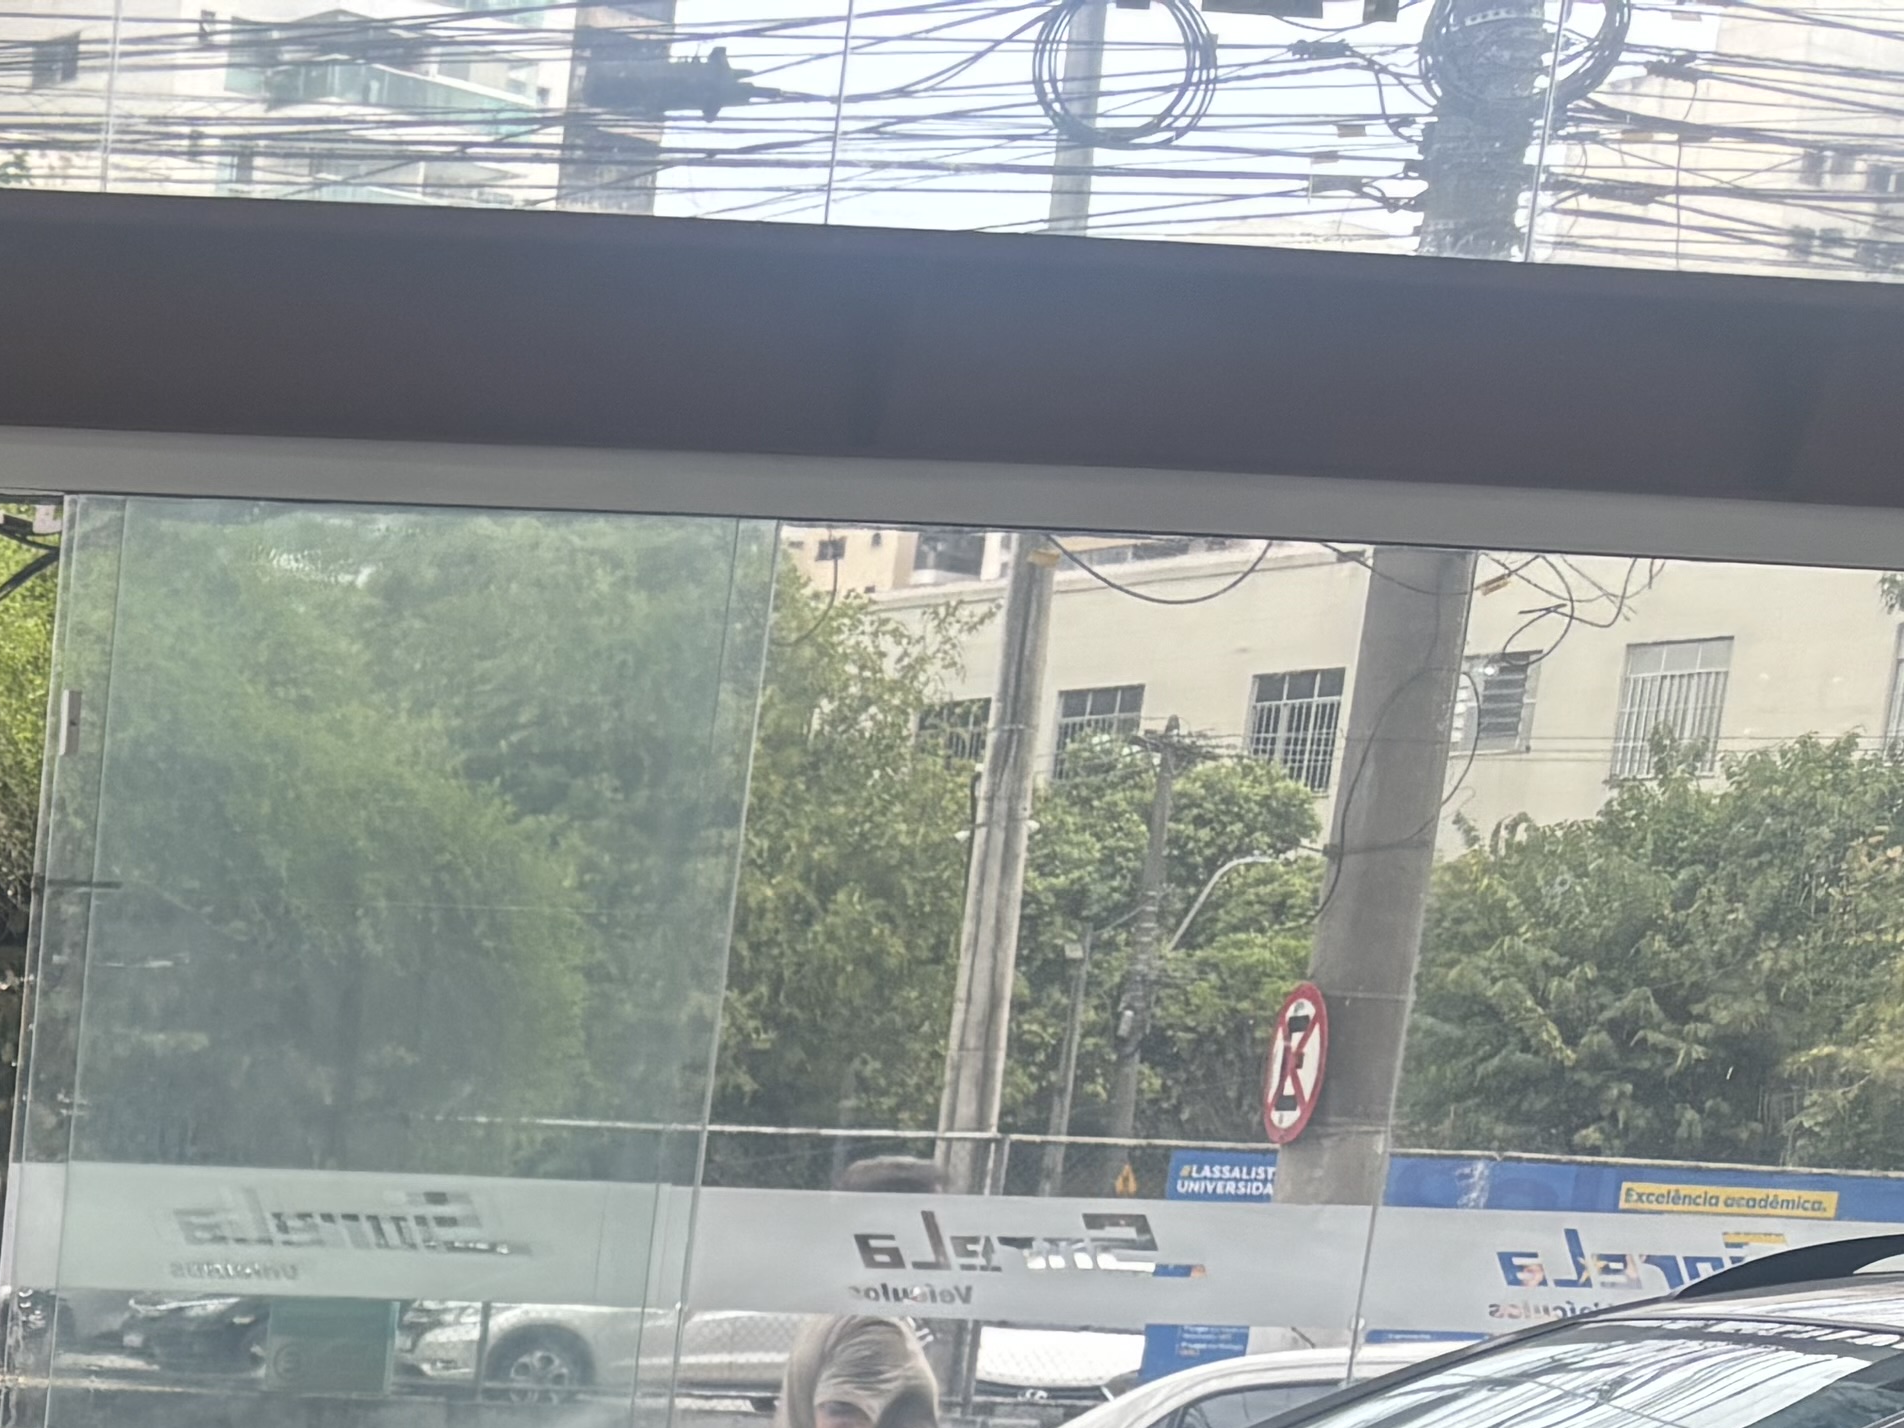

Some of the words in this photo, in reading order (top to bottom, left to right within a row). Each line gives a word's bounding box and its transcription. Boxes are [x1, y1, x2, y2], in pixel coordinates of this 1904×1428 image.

[1179, 1164, 1276, 1180] #LASSALIST
[1176, 1179, 1274, 1196] UNIVERSIDA
[1623, 1187, 1720, 1208] Excelência
